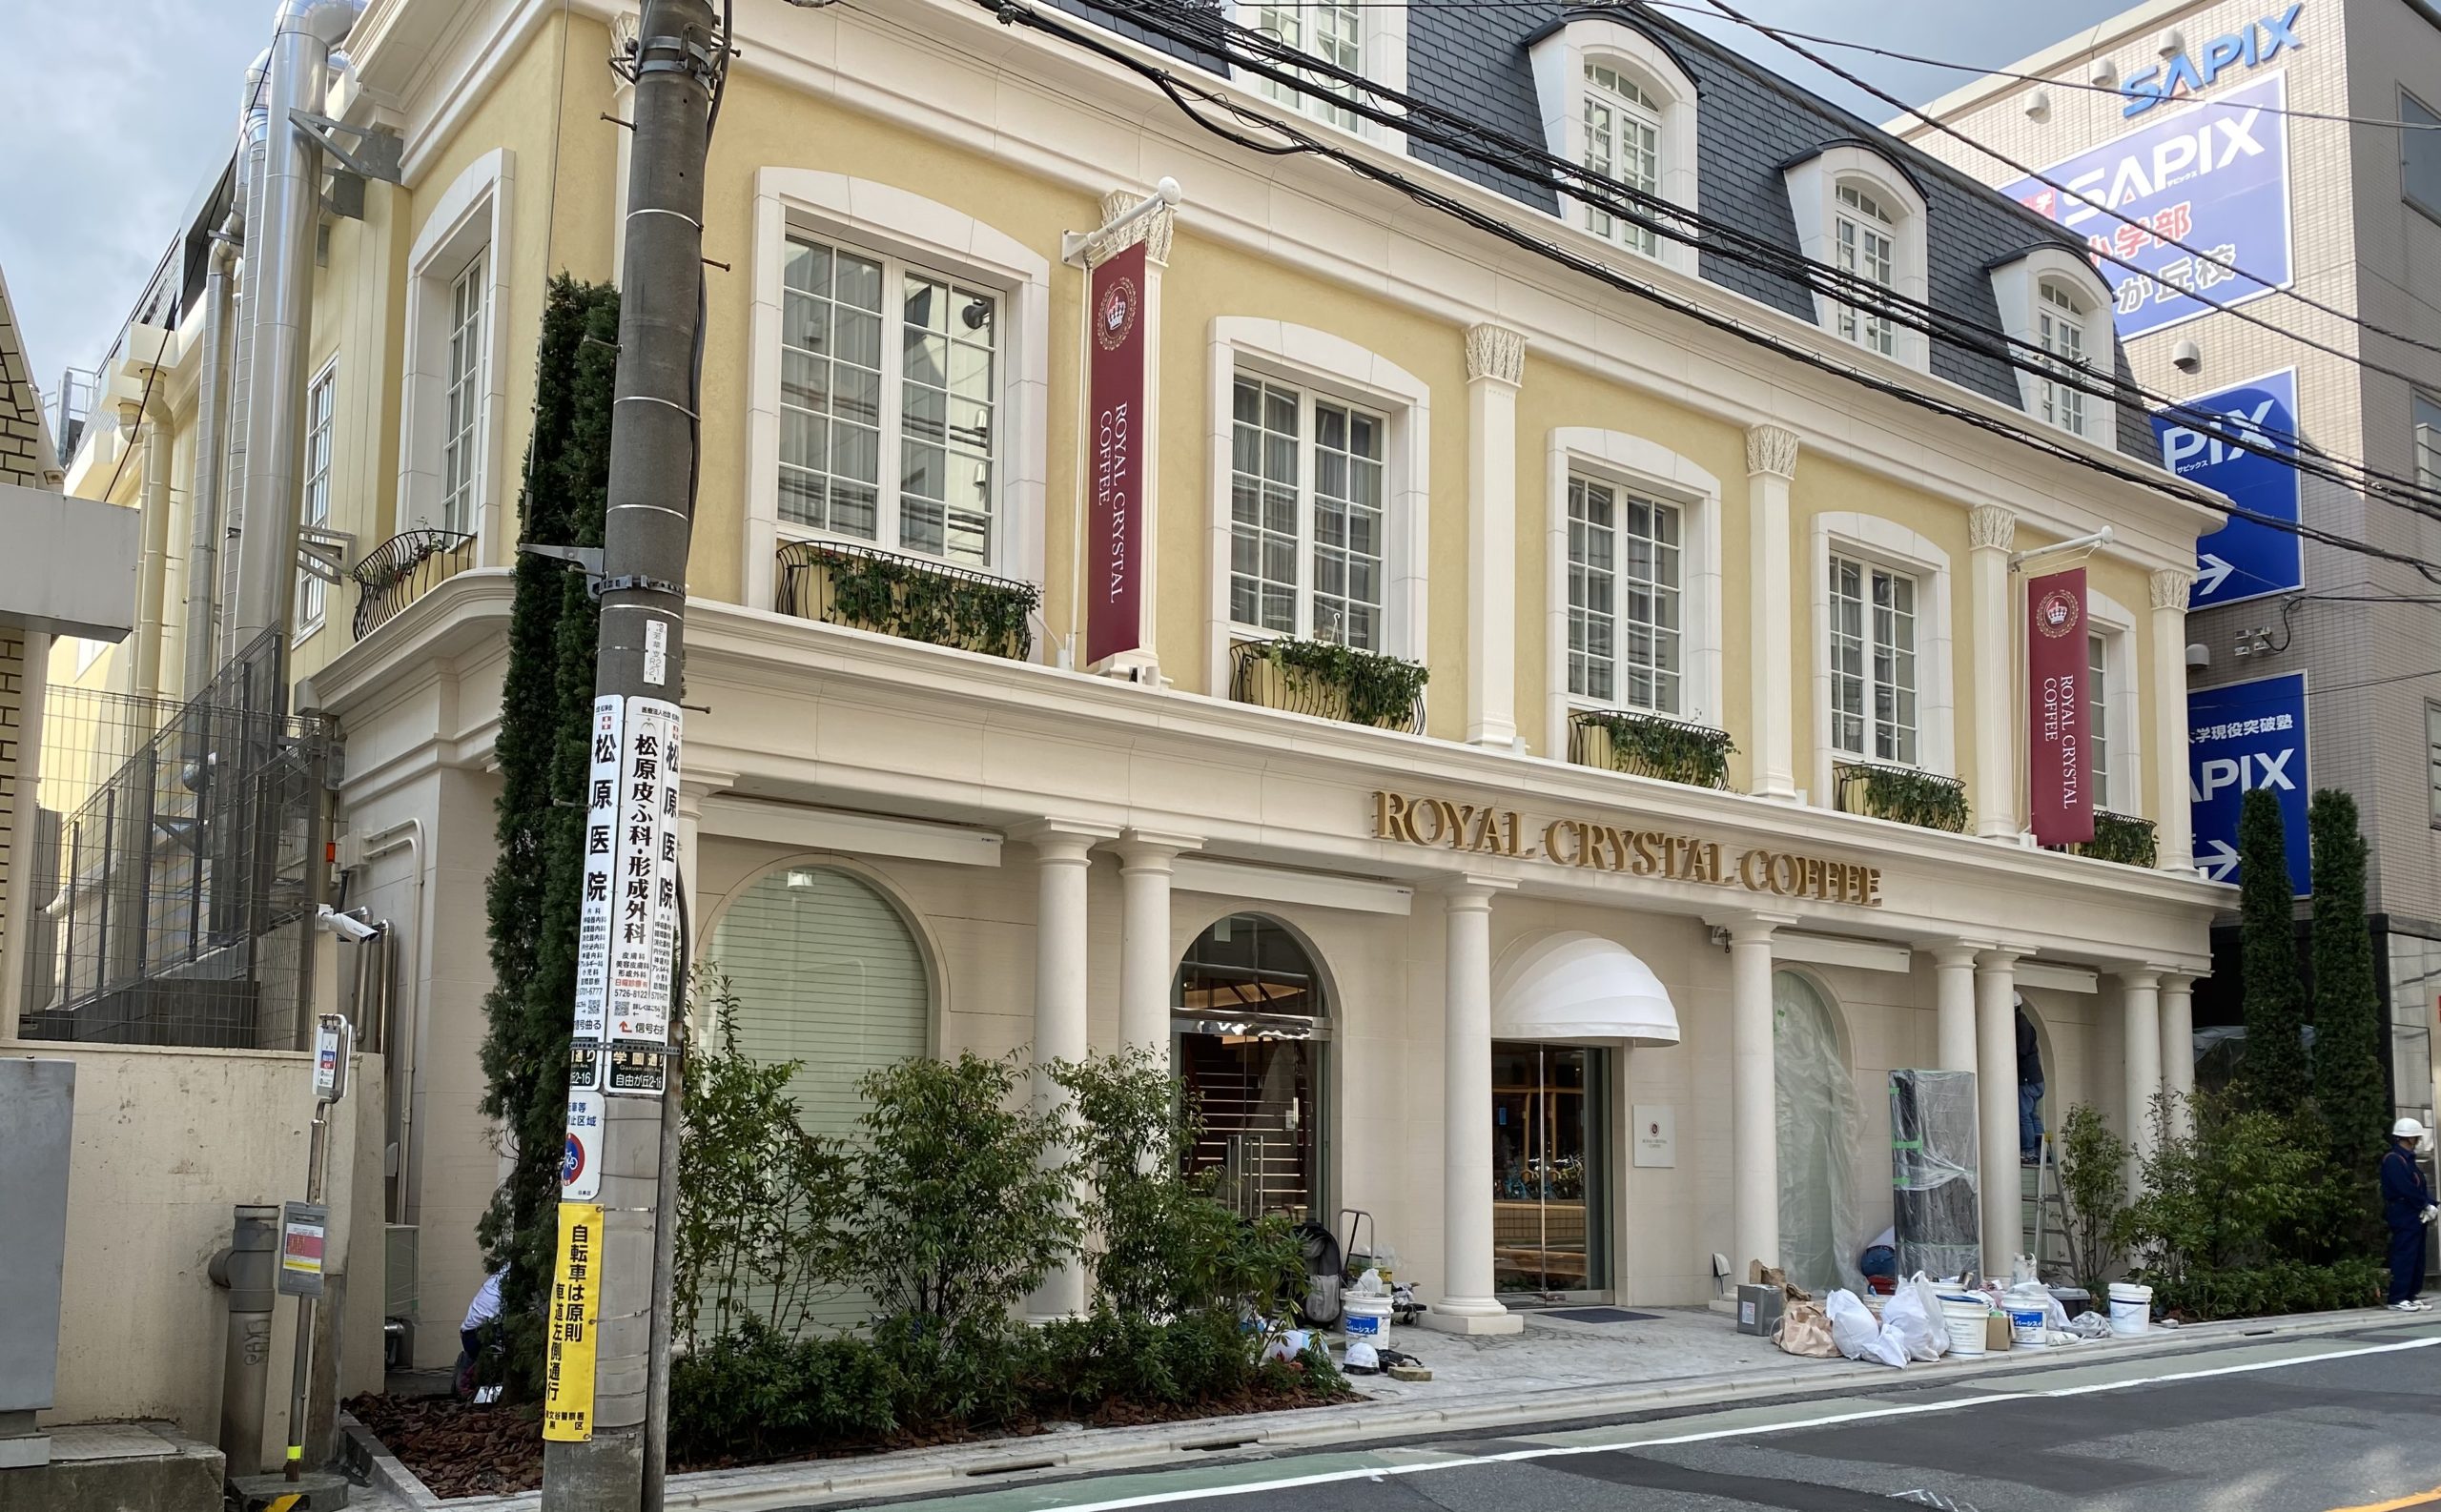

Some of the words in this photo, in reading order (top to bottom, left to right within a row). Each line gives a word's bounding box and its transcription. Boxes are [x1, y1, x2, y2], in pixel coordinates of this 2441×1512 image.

[2121, 3, 2303, 118] SAPIX
[2062, 104, 2266, 226] SAPIX
[1098, 410, 1113, 506] COFFEE
[1113, 400, 1128, 486] ROYAL
[2177, 460, 2208, 474] サピックス
[1110, 492, 1126, 603] CRYSTAL
[2043, 677, 2058, 742] COFFEE
[2060, 673, 2075, 731] ROYAL
[585, 733, 617, 903] 松原医院
[2062, 735, 2078, 809] CRYSTAL
[624, 733, 659, 945] 松原皮ふ科・形成外科
[1371, 790, 1534, 859] ROYAL
[1544, 820, 1734, 886] CRYSTAL
[1739, 848, 1882, 907] COFFEE
[571, 1050, 596, 1063] 通り
[564, 1224, 588, 1343] 自転車は原則
